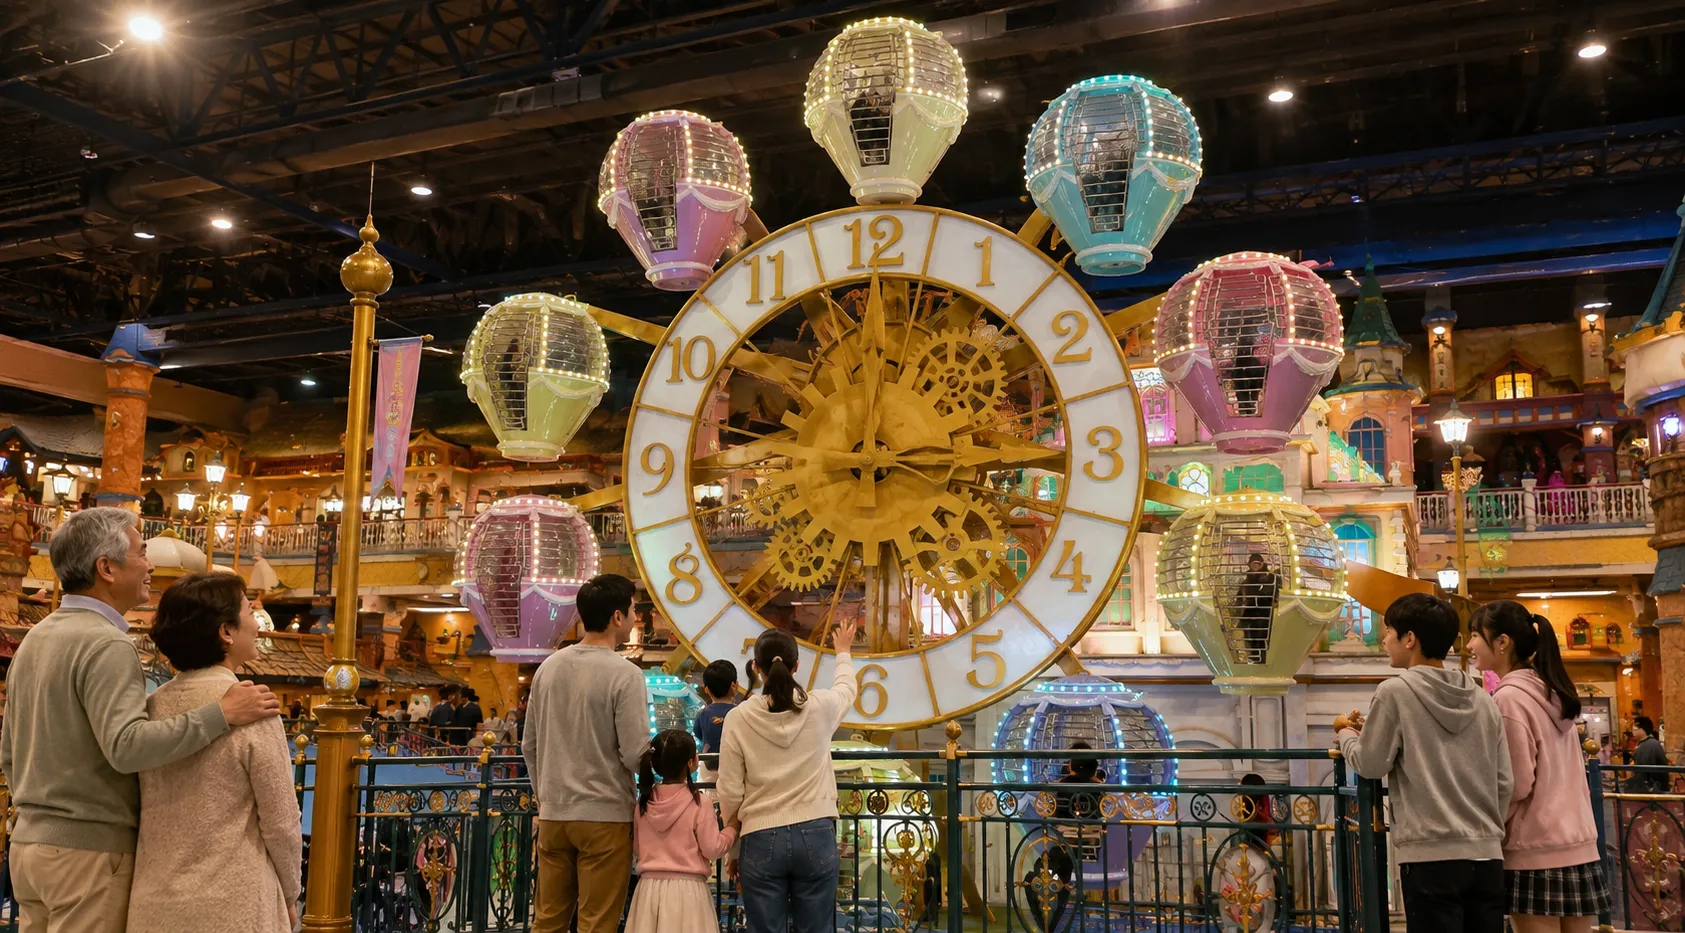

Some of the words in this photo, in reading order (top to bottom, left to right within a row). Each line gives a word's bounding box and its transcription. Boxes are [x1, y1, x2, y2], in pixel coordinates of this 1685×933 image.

[843, 214, 904, 270] 12
[974, 236, 994, 287] 1
[743, 249, 787, 304] 11
[665, 335, 716, 383] 10
[1051, 310, 1092, 364] 2
[640, 442, 675, 495] 9
[1083, 426, 1124, 481] 3
[665, 543, 702, 605] 8
[1051, 540, 1092, 592] 4
[967, 630, 1005, 689] 5
[853, 664, 888, 718] 6
